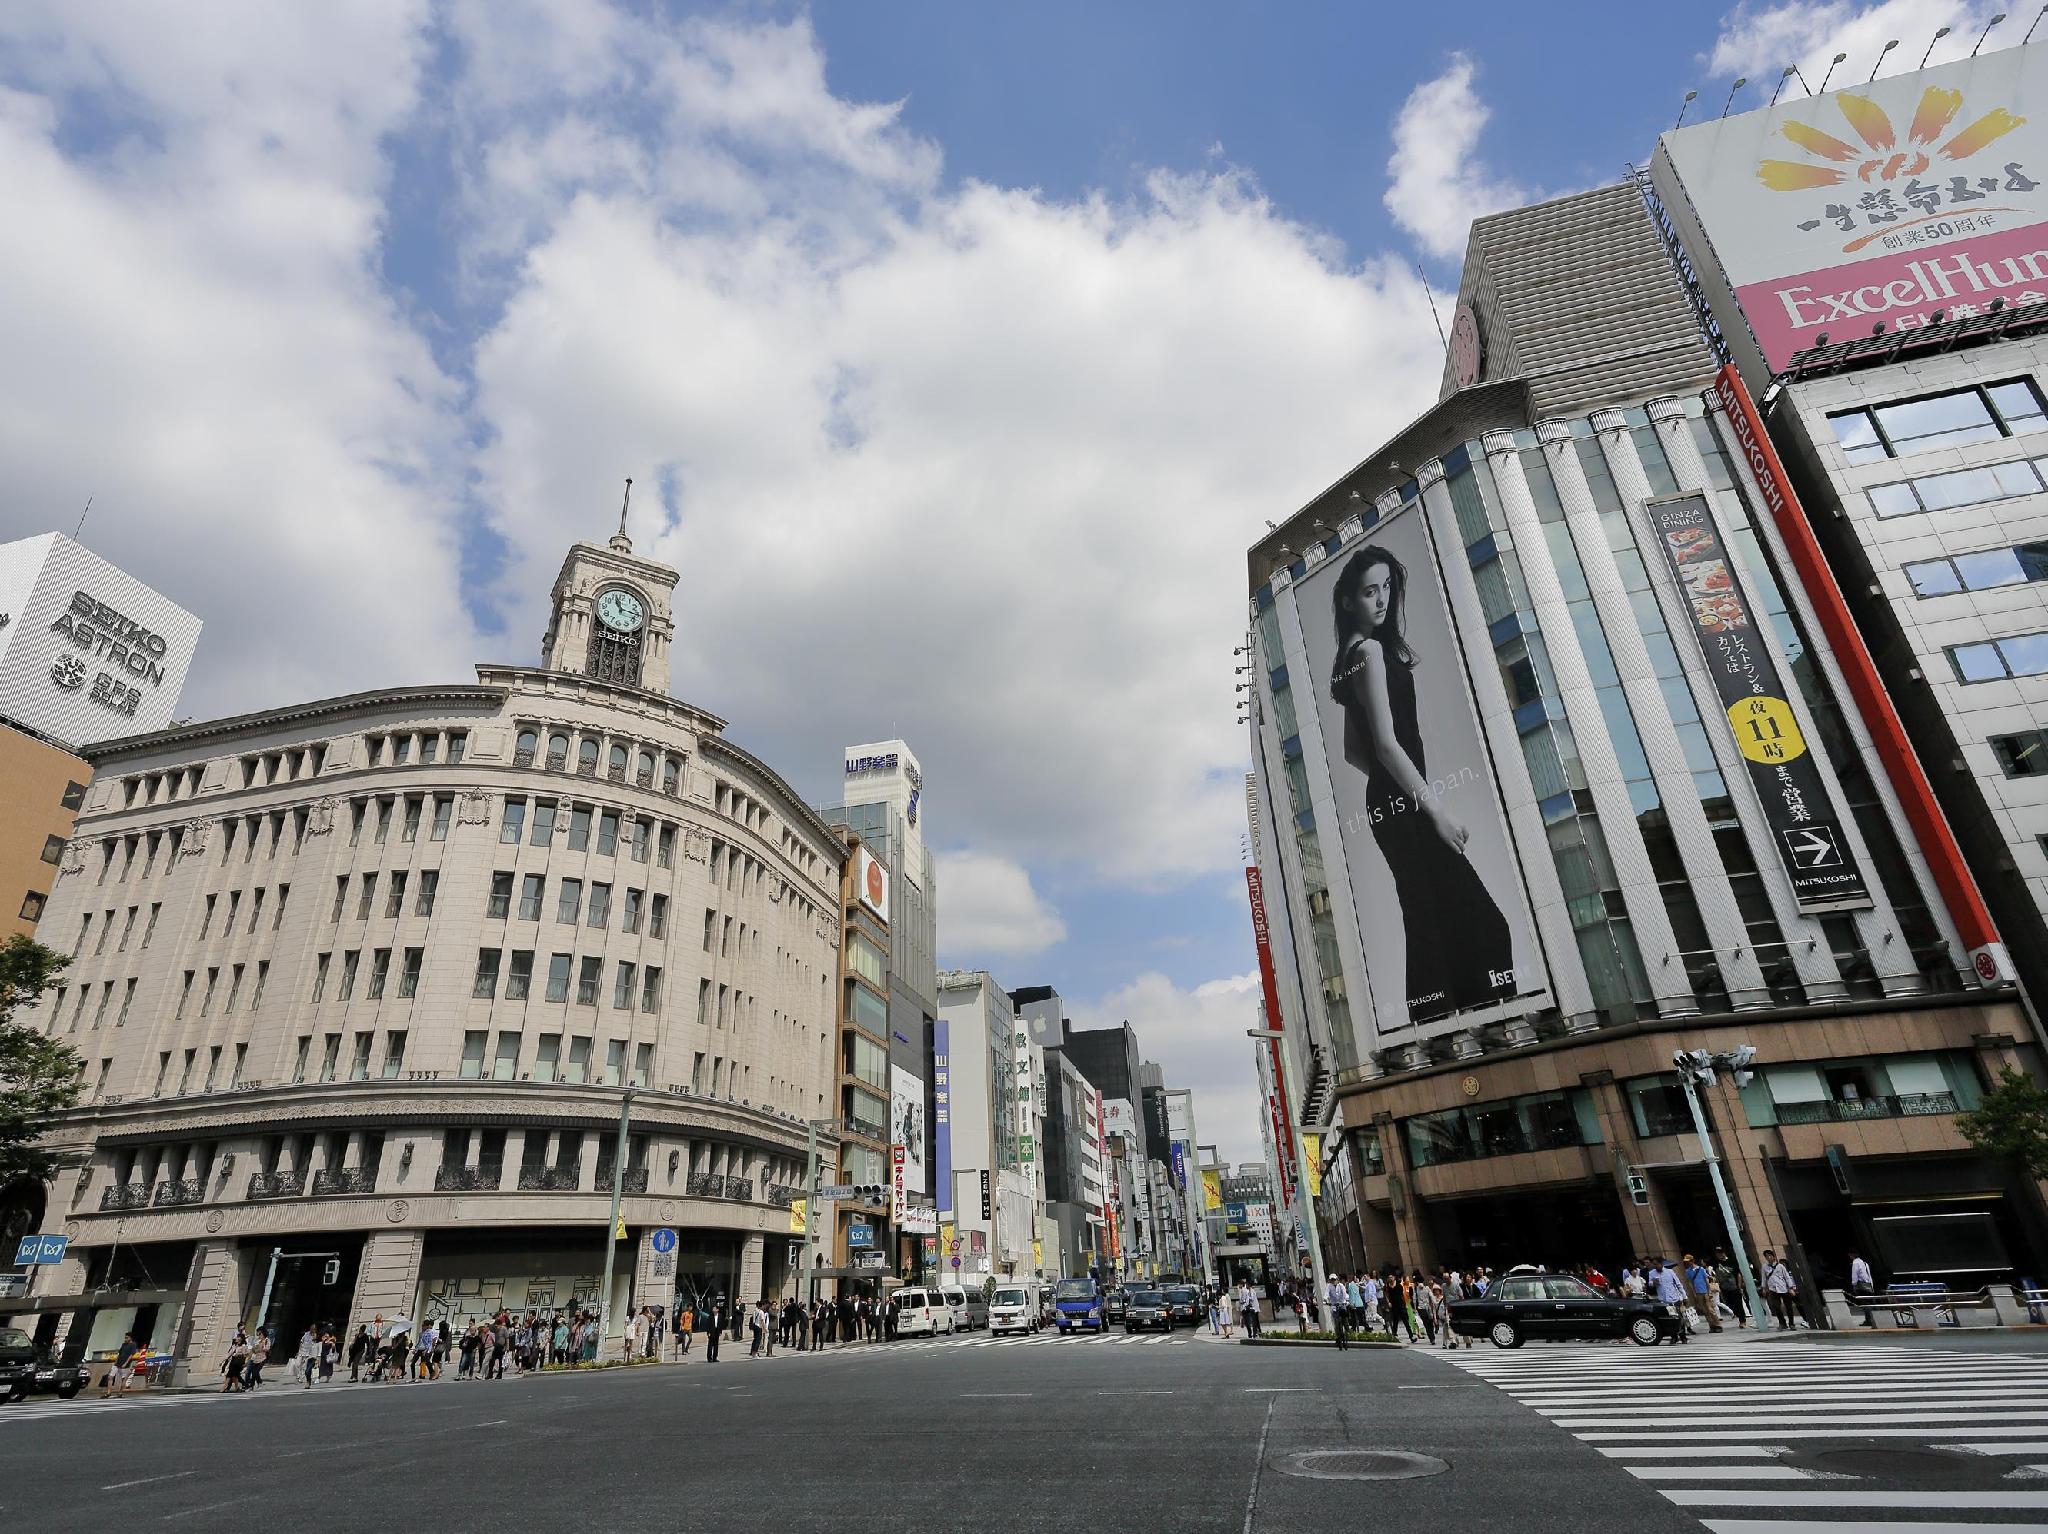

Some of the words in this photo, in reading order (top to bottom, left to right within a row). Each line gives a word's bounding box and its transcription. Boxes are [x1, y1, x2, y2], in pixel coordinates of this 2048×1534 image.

[1881, 214, 1996, 250] 創業50周年
[1721, 379, 1784, 513] MITSUKOSHI
[1660, 509, 1700, 522] GINZA
[1662, 516, 1704, 529] DINING
[70, 590, 167, 658] SEIKO
[598, 630, 638, 646] SEIKO
[51, 613, 166, 687] ASTRON
[1716, 636, 1740, 674] カフェは
[1732, 634, 1765, 694] レストラン&
[90, 686, 138, 716] SOLAR
[95, 671, 142, 704] GPS
[846, 753, 898, 774] 山野楽器
[1346, 804, 1383, 834] this
[1388, 795, 1406, 815] is
[1411, 765, 1480, 812] japan.
[1775, 765, 1811, 822] まで営業
[1795, 873, 1857, 887] MITSUKOSHI
[1248, 872, 1267, 944] MITSUKOSHI
[935, 1055, 948, 1123] 山野楽器
[1020, 1140, 1033, 1157] 本
